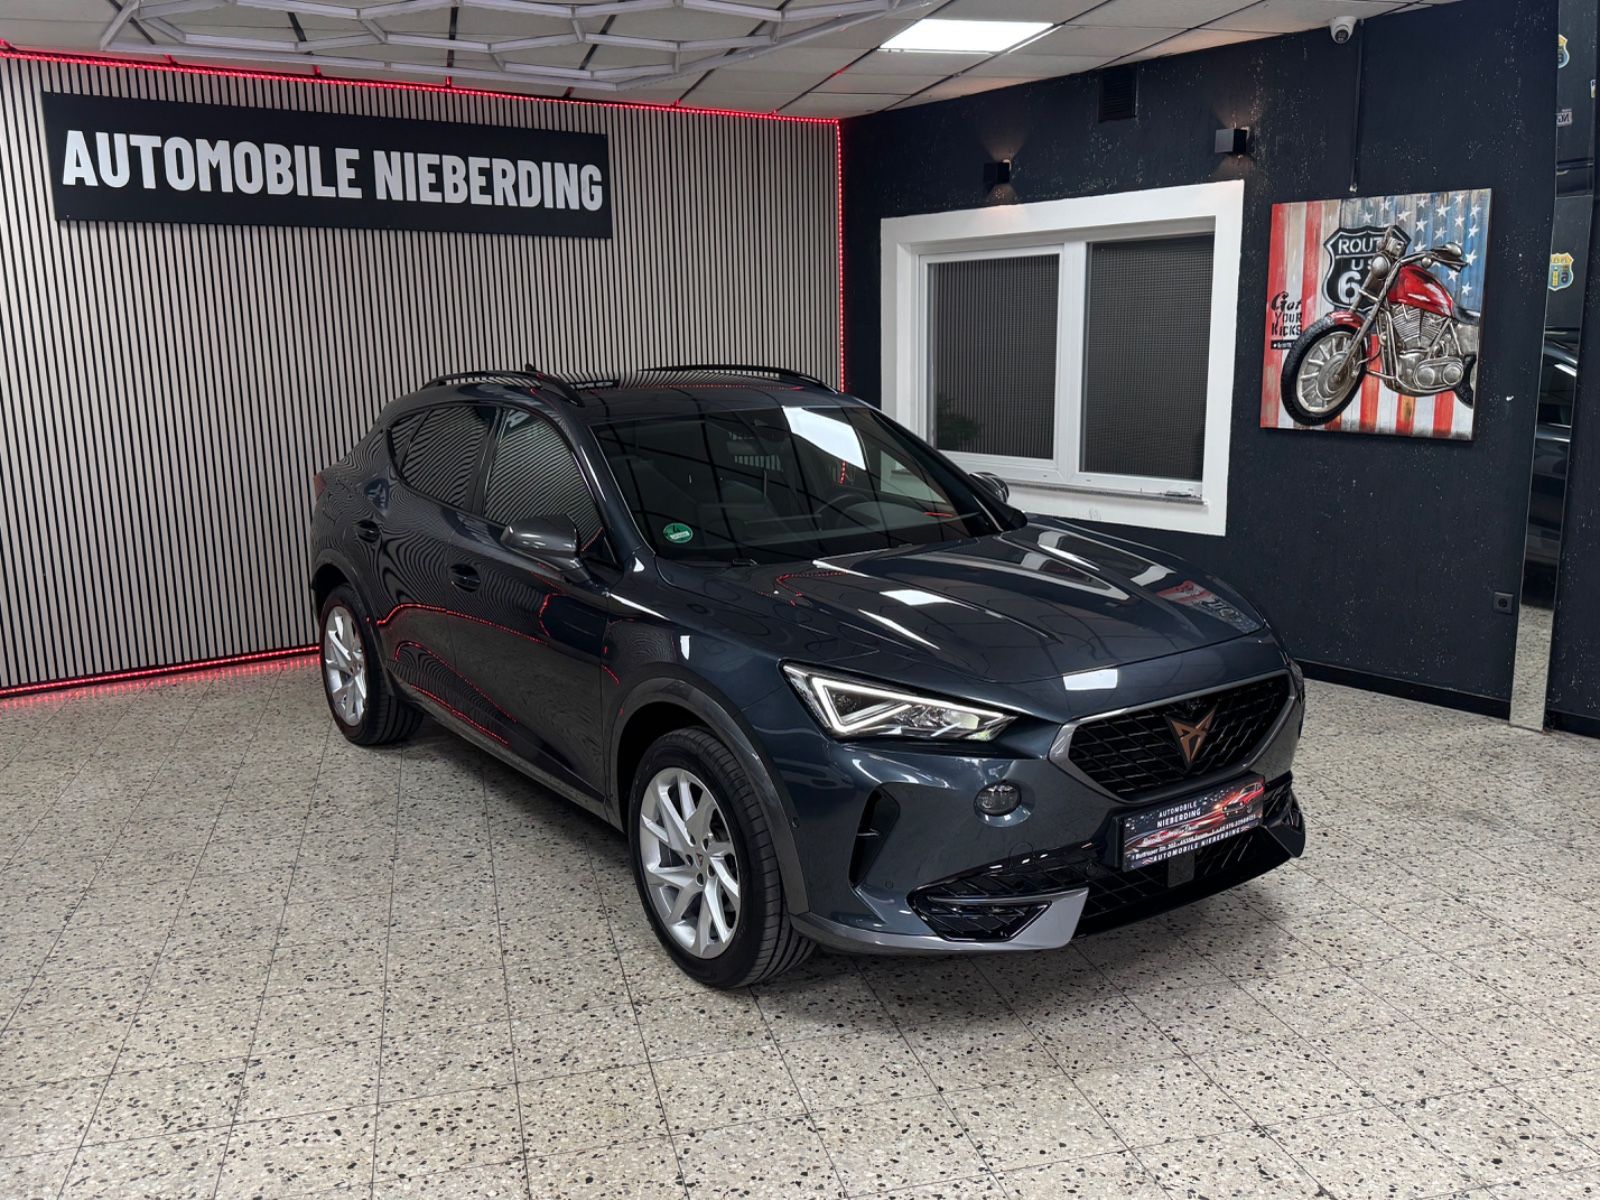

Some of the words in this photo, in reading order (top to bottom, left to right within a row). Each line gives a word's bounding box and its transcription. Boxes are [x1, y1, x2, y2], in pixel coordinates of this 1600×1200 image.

[62, 130, 362, 199] AUTOMOBILE
[374, 151, 603, 211] NIEBERDING
[1338, 237, 1379, 254] ROUT
[1157, 808, 1201, 828] NIEBERDING
[1158, 801, 1197, 818] AUTOMOBILE
[1201, 827, 1240, 847] NIEBERDING
[1153, 842, 1199, 862] AUTOMOBILE
